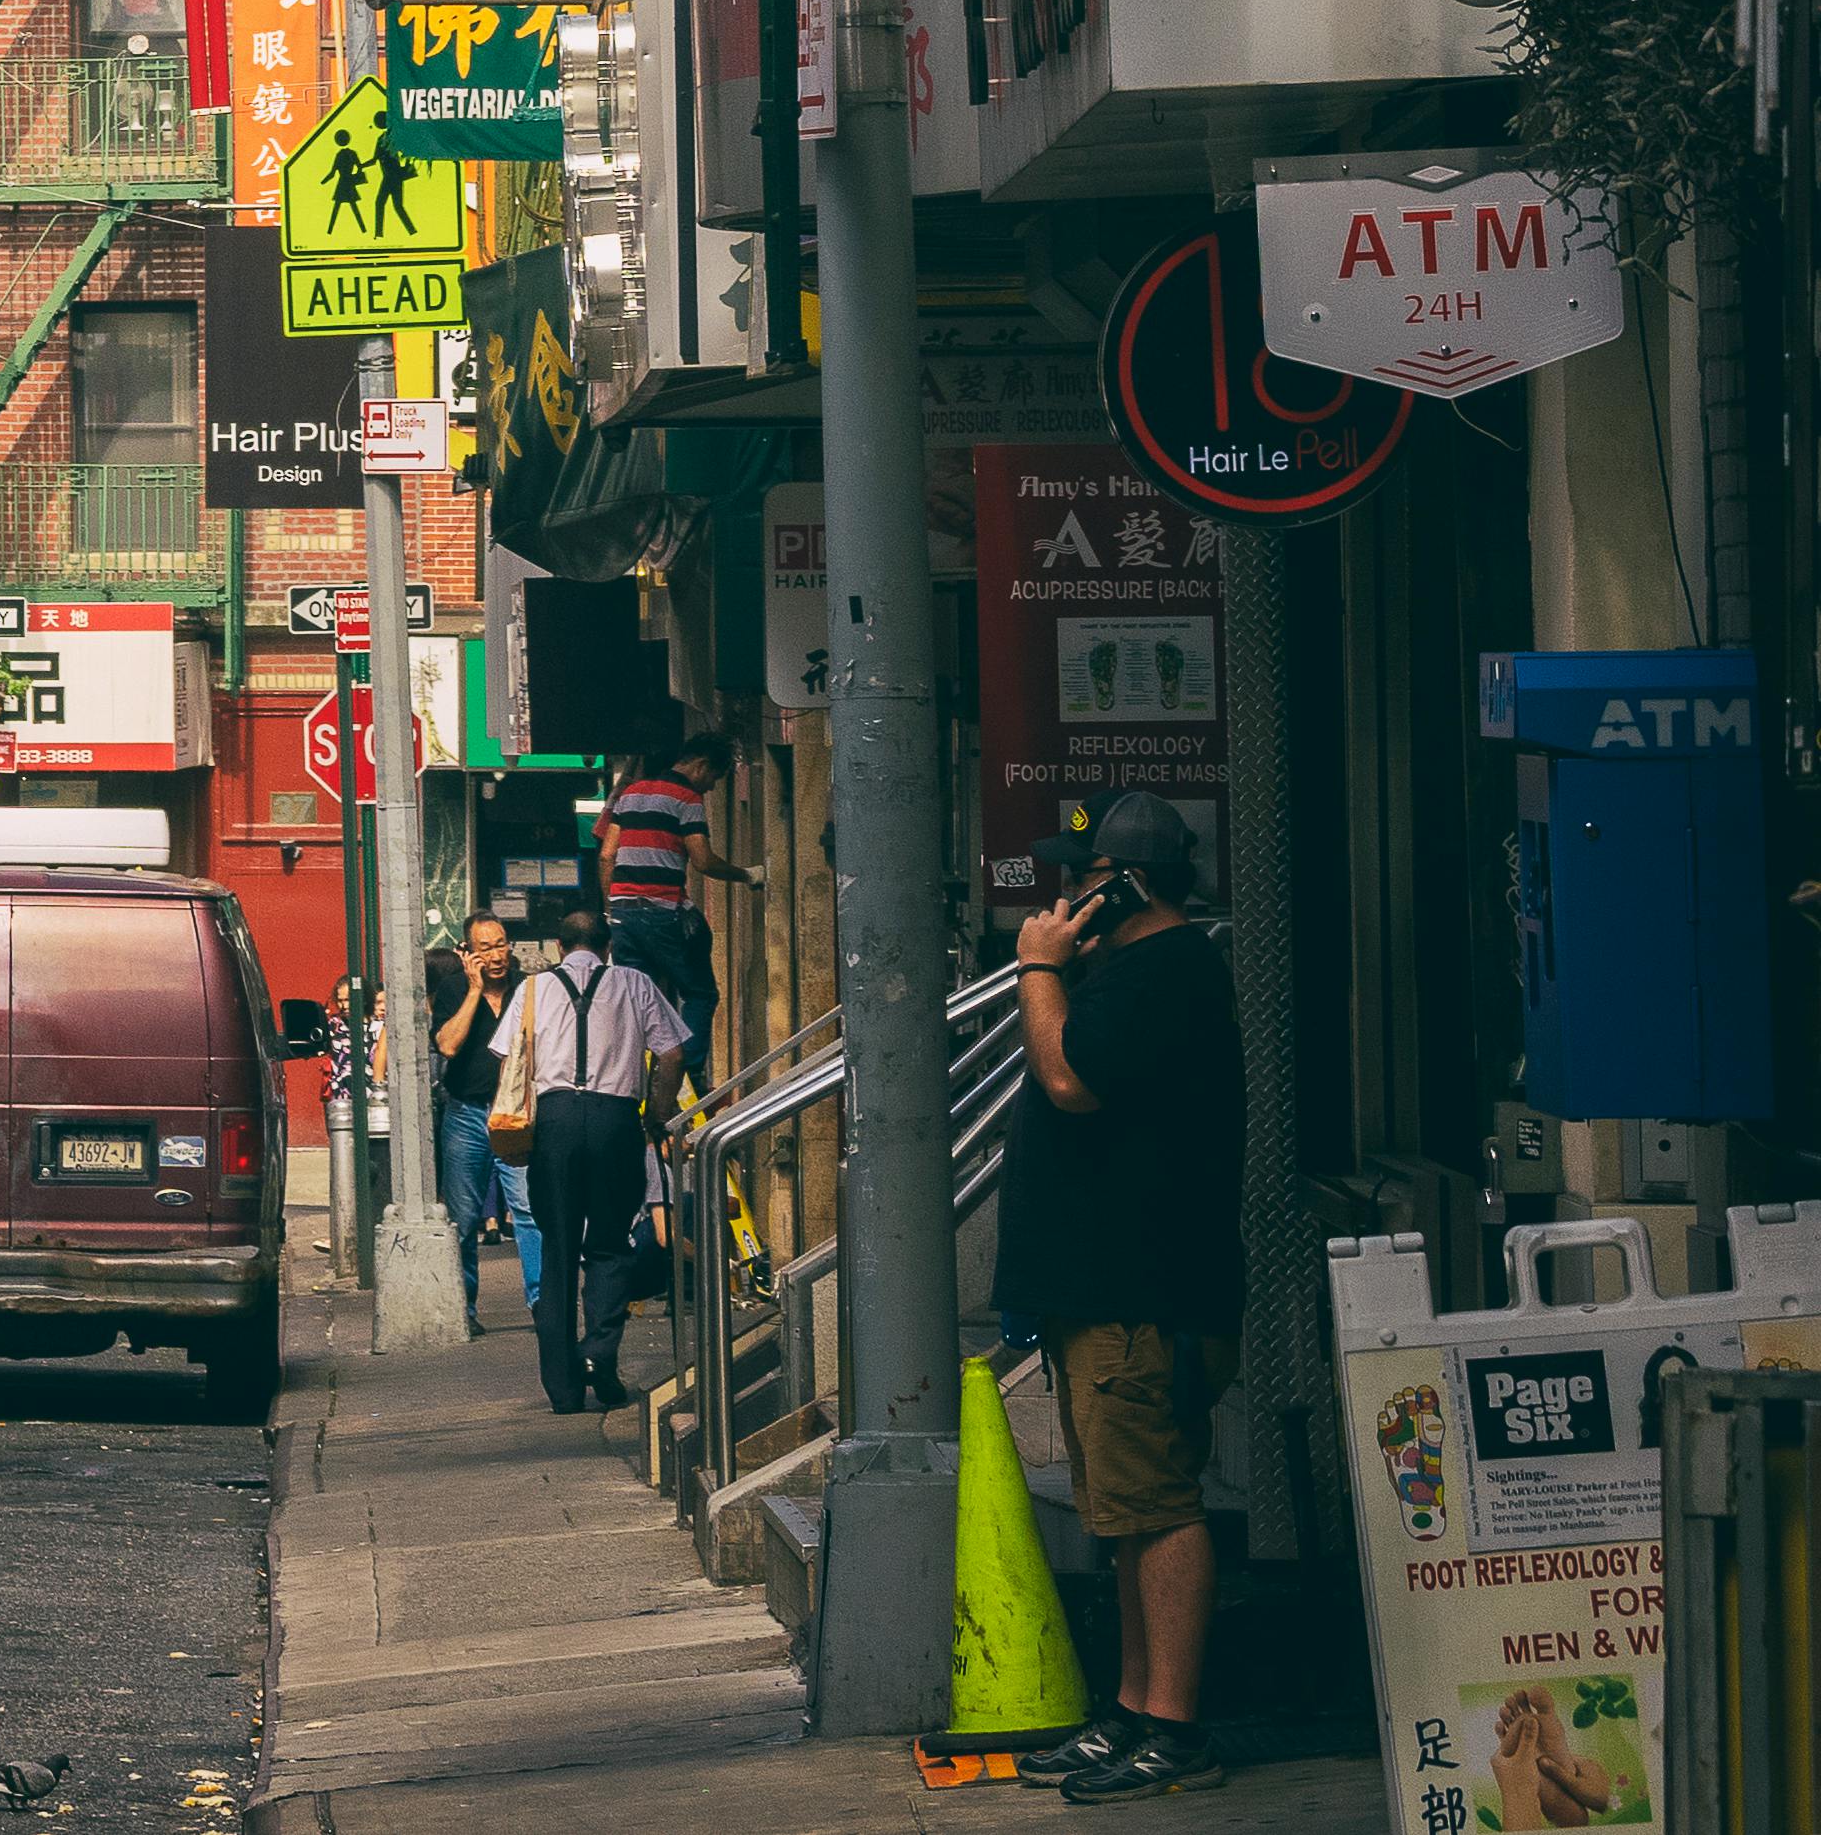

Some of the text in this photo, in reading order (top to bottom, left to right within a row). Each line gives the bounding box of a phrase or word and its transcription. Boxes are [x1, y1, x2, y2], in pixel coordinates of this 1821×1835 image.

[1337, 203, 1550, 281] ATM
[307, 273, 448, 317] AHEAD
[1403, 291, 1484, 325] 24H
[212, 421, 364, 453] Hair Plus
[1188, 428, 1358, 475] Hair Le Pell
[257, 463, 323, 485] Design
[1017, 475, 1099, 501] Amy's
[1010, 579, 1208, 604] ACUPRESSURE (BACK
[1590, 698, 1752, 749] ATM
[1068, 736, 1207, 755] REFLEXOLOGY
[1005, 762, 1231, 788] (FOOT RUB (FACE MASS
[161, 1145, 204, 1158] SUNOCO
[1484, 1372, 1594, 1413] Page
[1504, 1406, 1574, 1444] Six
[1406, 1558, 1468, 1592] FOOT
[1473, 1545, 1640, 1587] REFLEXOLOGY
[1589, 1585, 1665, 1619] FOR
[1501, 1630, 1581, 1665] MEN
[1592, 1628, 1618, 1659] &
